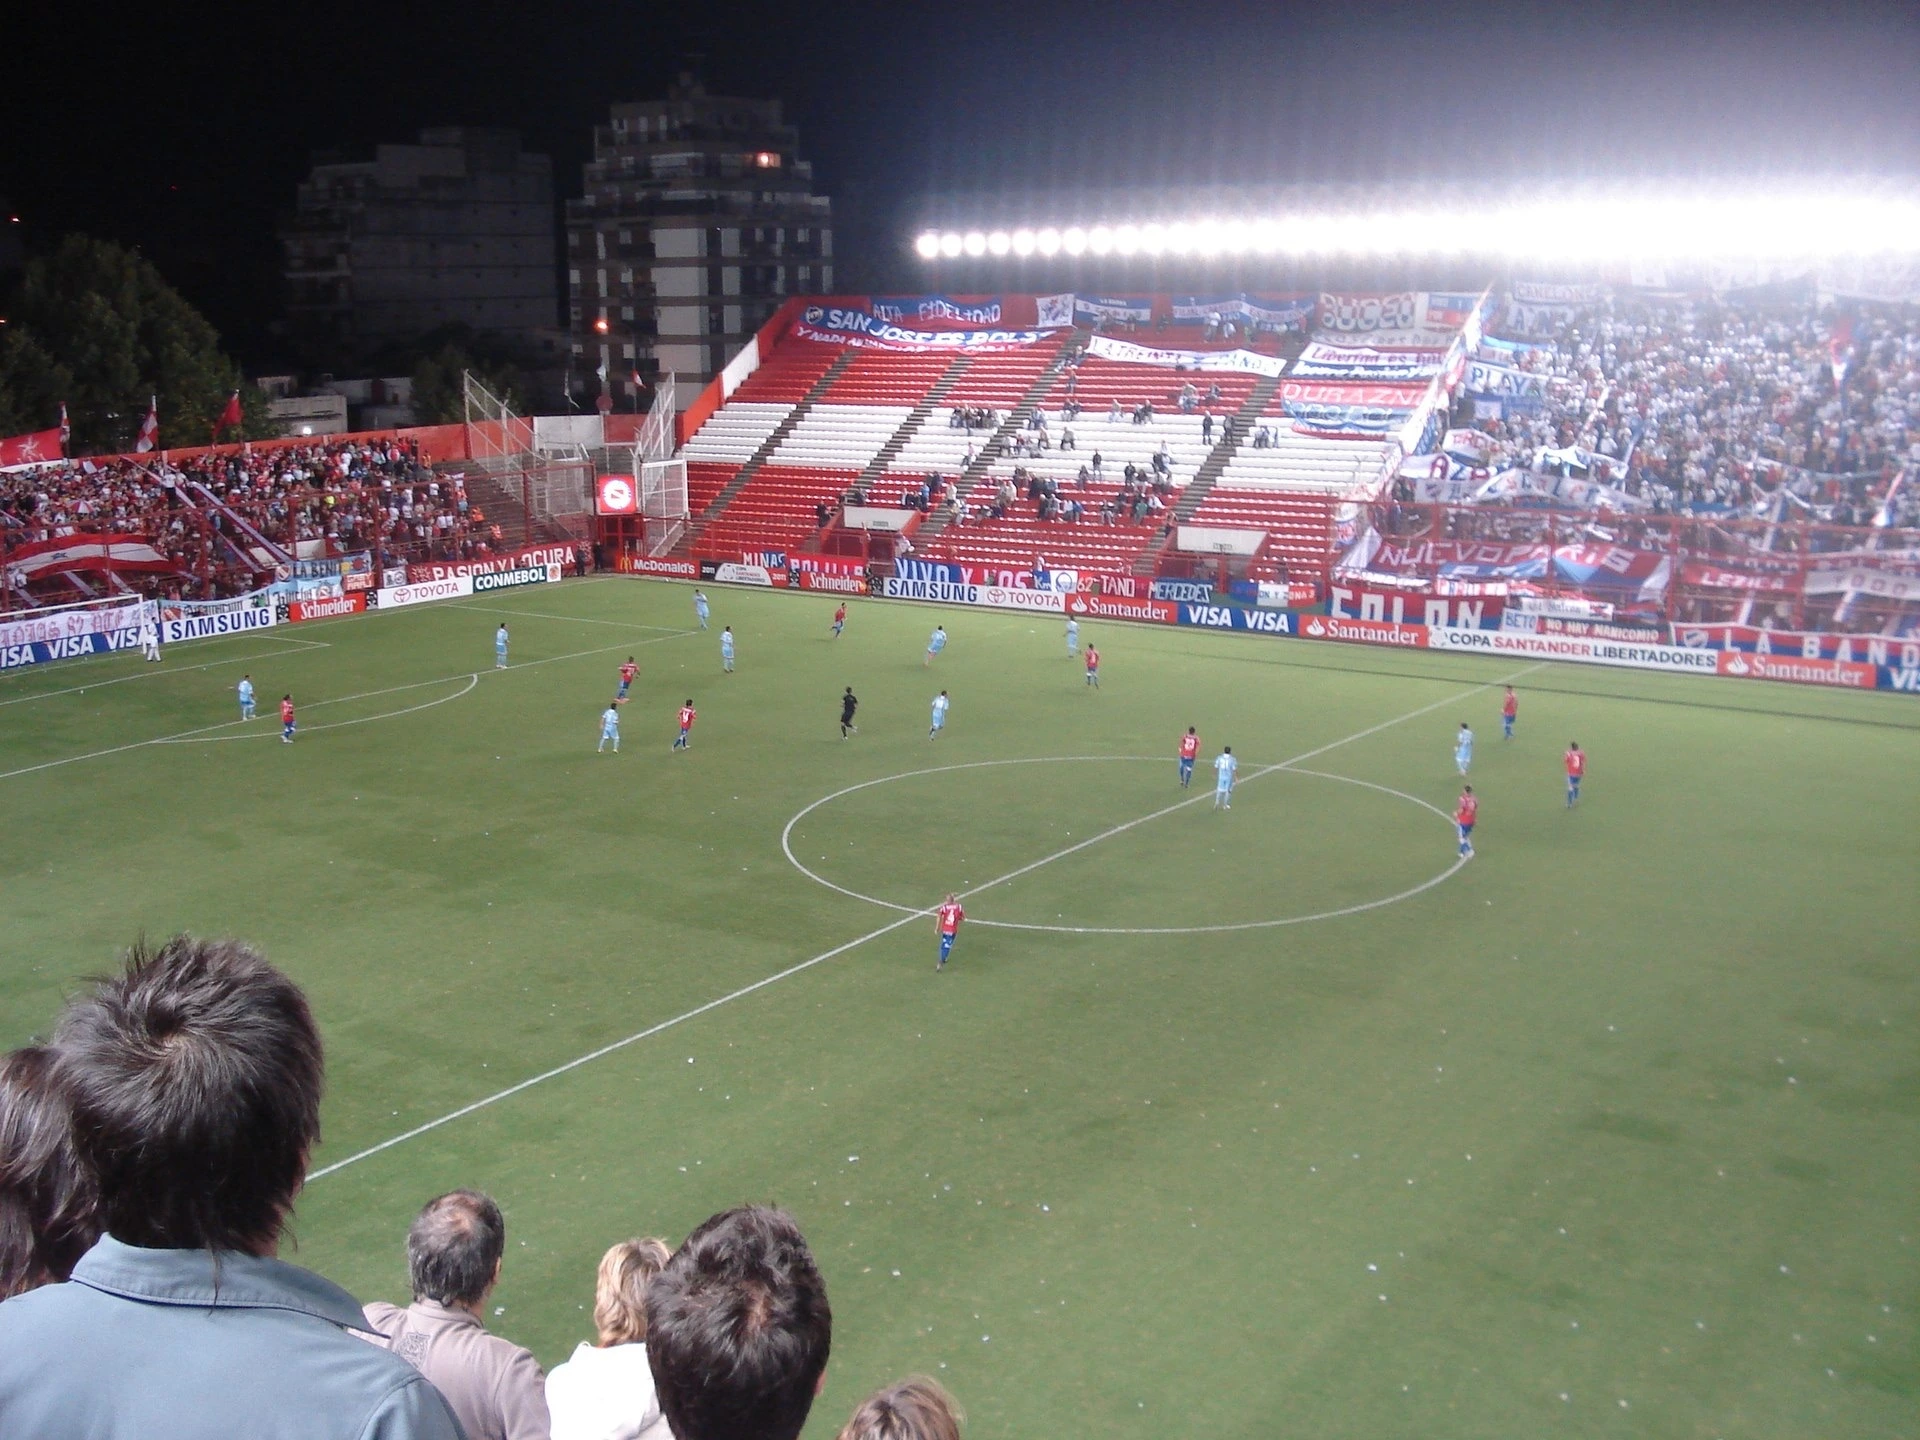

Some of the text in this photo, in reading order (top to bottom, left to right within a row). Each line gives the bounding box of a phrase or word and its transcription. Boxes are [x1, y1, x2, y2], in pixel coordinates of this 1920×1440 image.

[827, 309, 873, 332] SAN
[633, 558, 695, 574] McDonald's
[1378, 541, 1505, 567] NUEVO
[474, 567, 546, 590] CONMEBOL
[809, 571, 861, 593] Schneider
[888, 577, 979, 602] SAMSUNG
[412, 582, 459, 601] TOYOTA
[1008, 591, 1061, 608] TOYOTA
[299, 597, 357, 620] Schneider
[1089, 597, 1169, 620] Santander
[1186, 604, 1233, 628] VISA
[171, 608, 270, 640] SAMSUNG
[1242, 609, 1290, 633] VISA
[1326, 618, 1419, 646] Santander
[0, 644, 35, 668] ISA
[43, 634, 94, 660] VISA
[1449, 632, 1716, 668] COPA SANTANDER LIBERTADORES
[1752, 655, 1865, 686] Santander
[1888, 666, 1920, 692] VI
